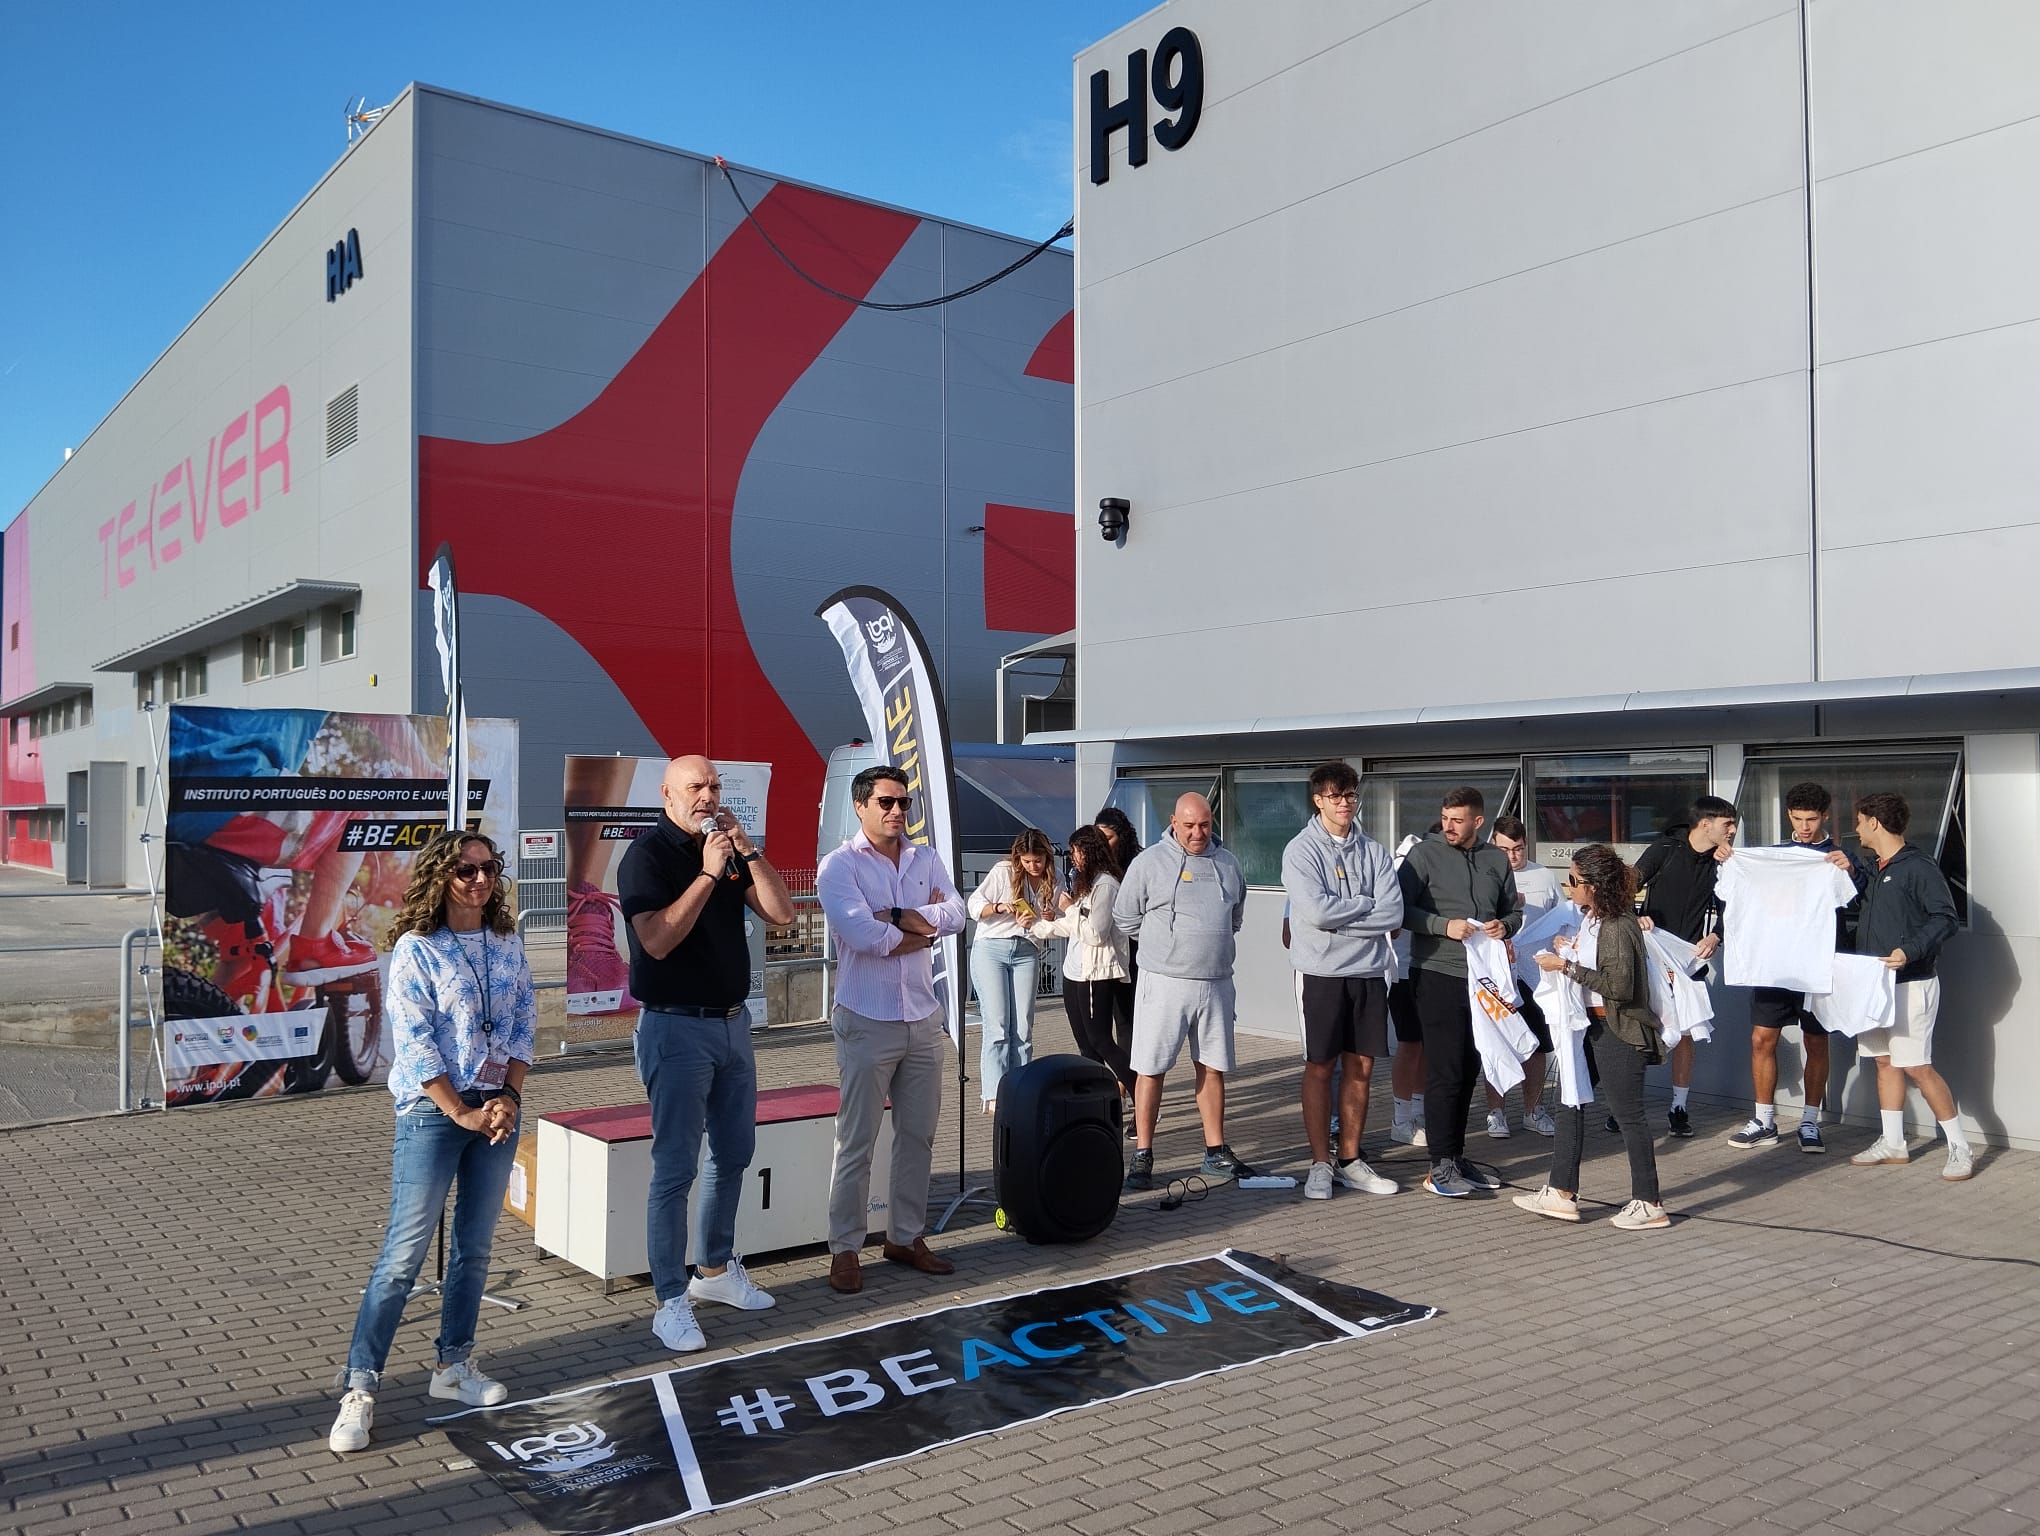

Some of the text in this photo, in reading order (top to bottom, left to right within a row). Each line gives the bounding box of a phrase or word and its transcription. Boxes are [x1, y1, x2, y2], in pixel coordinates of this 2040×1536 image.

[1090, 26, 1205, 186] H9
[326, 227, 364, 302] HA
[184, 786, 483, 801] INSTITUTO PORTUGUÊS DO DESPORTO E JUVEDE
[731, 805, 759, 814] NAUTIC
[346, 823, 475, 846] #BEACT
[176, 1078, 241, 1093] www.ipdj.pt
[758, 1167, 772, 1210] 1
[716, 1281, 1281, 1435] #BEACTIVE
